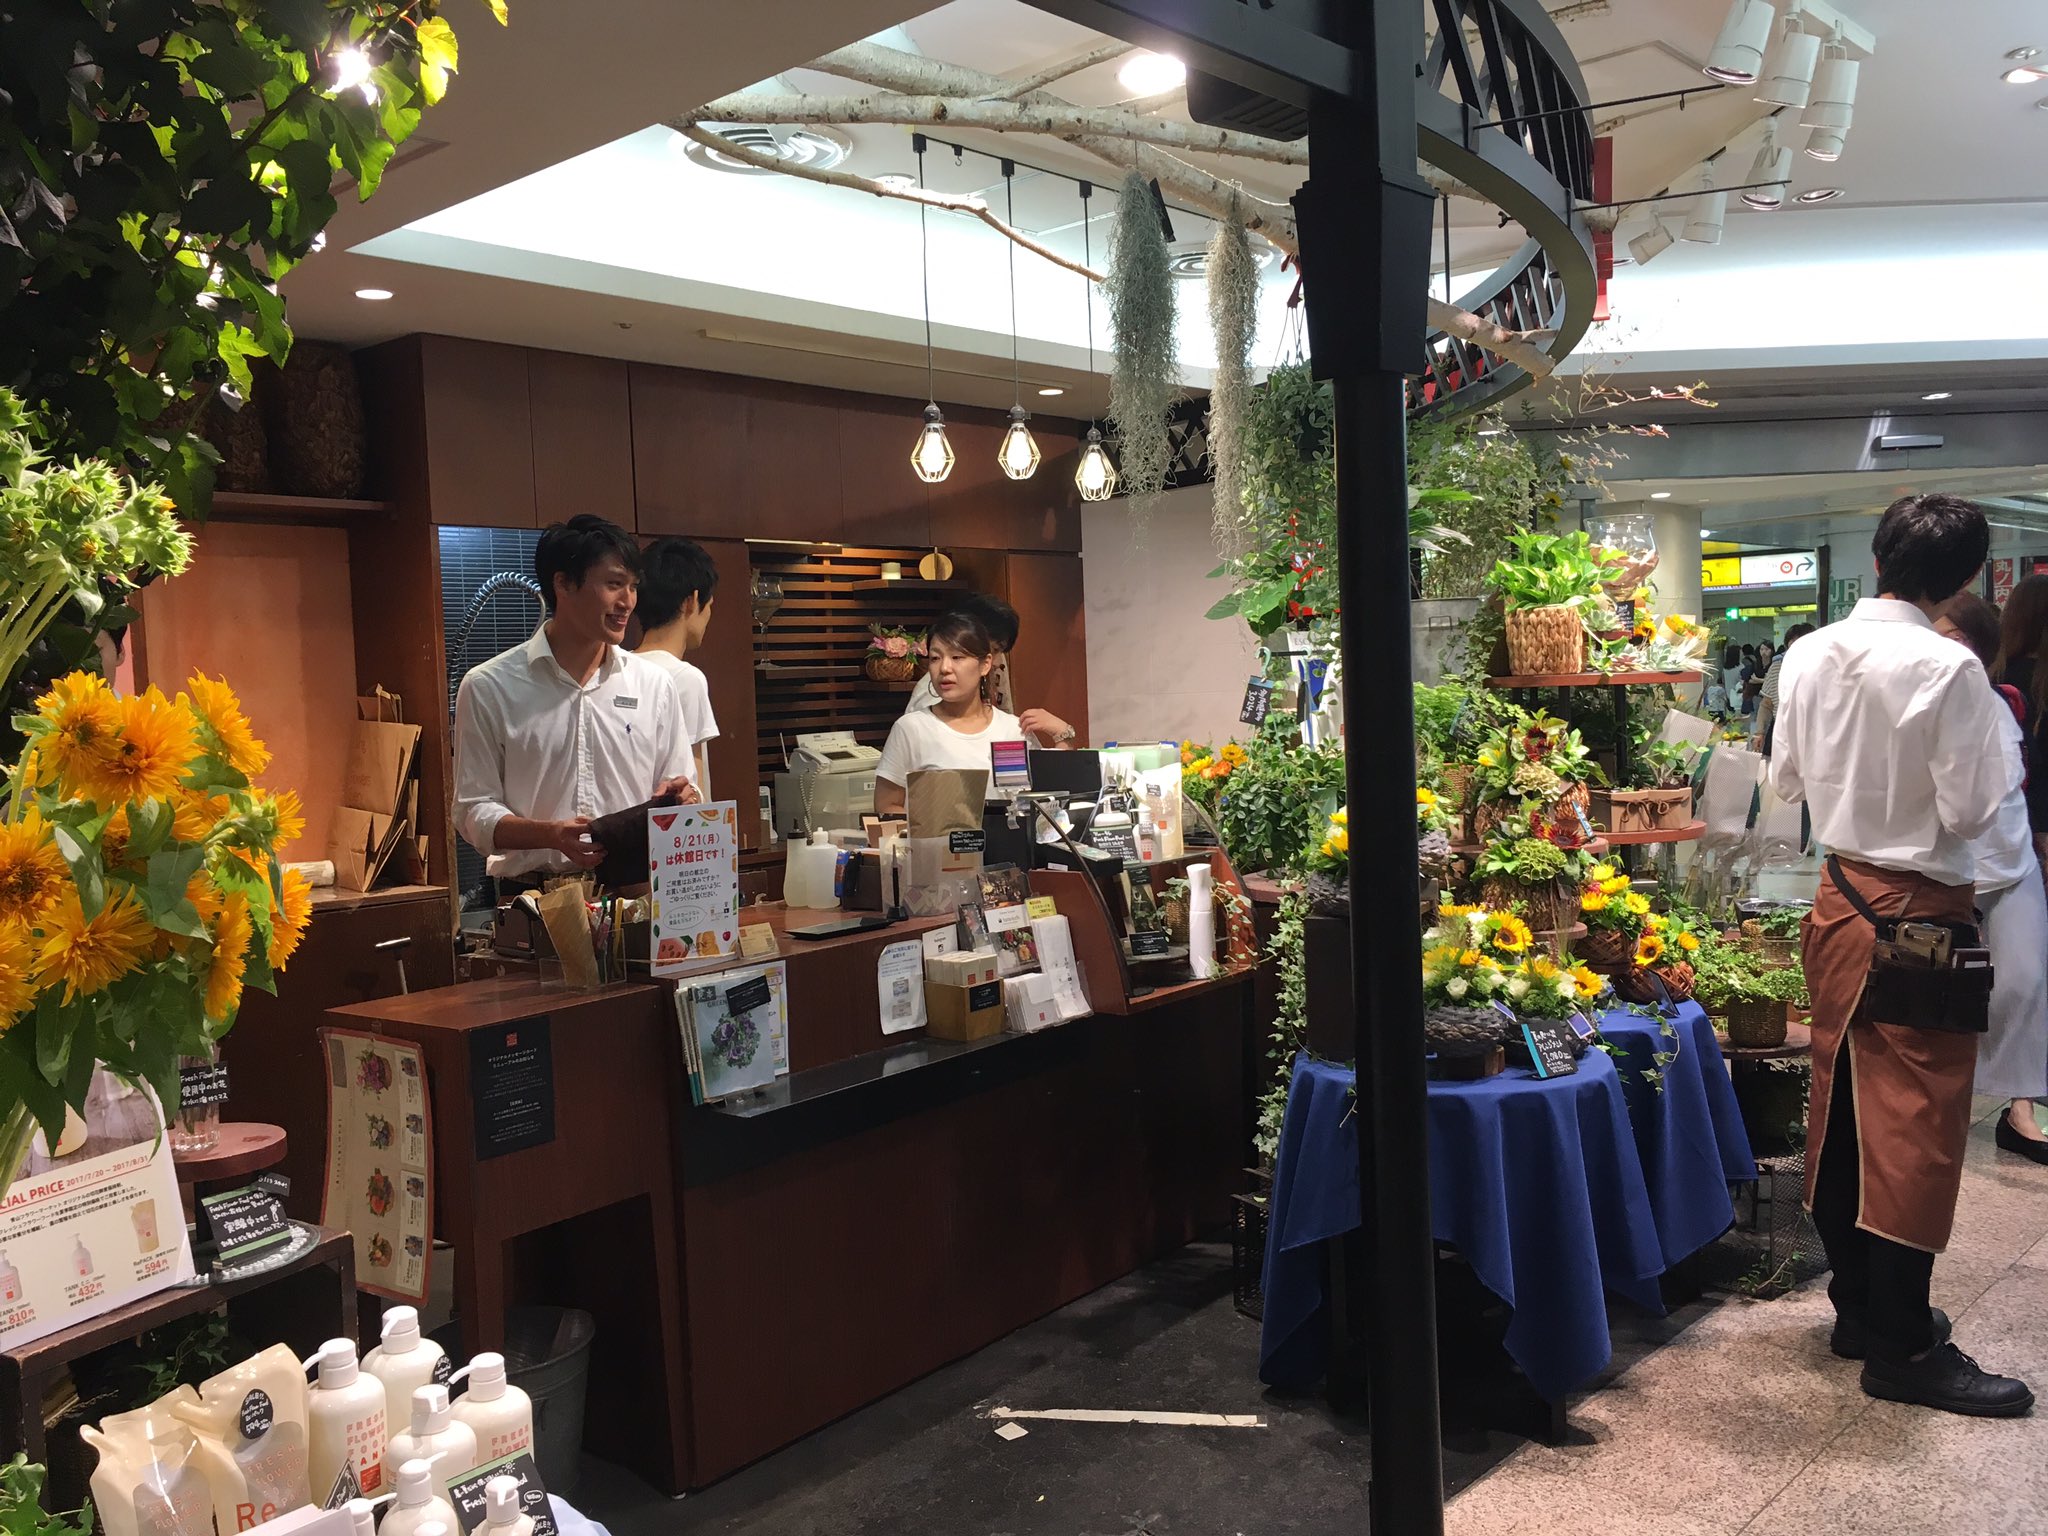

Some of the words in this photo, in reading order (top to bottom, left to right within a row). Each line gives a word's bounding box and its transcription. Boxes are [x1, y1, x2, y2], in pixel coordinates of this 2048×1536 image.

[1830, 579, 1860, 602] JR
[674, 833, 720, 849] 8/21(月)
[29, 1180, 65, 1200] PRICE
[67, 1169, 104, 1187] 2017/7/20
[113, 1155, 148, 1172] 2017/8/31
[236, 1502, 277, 1533] Re
